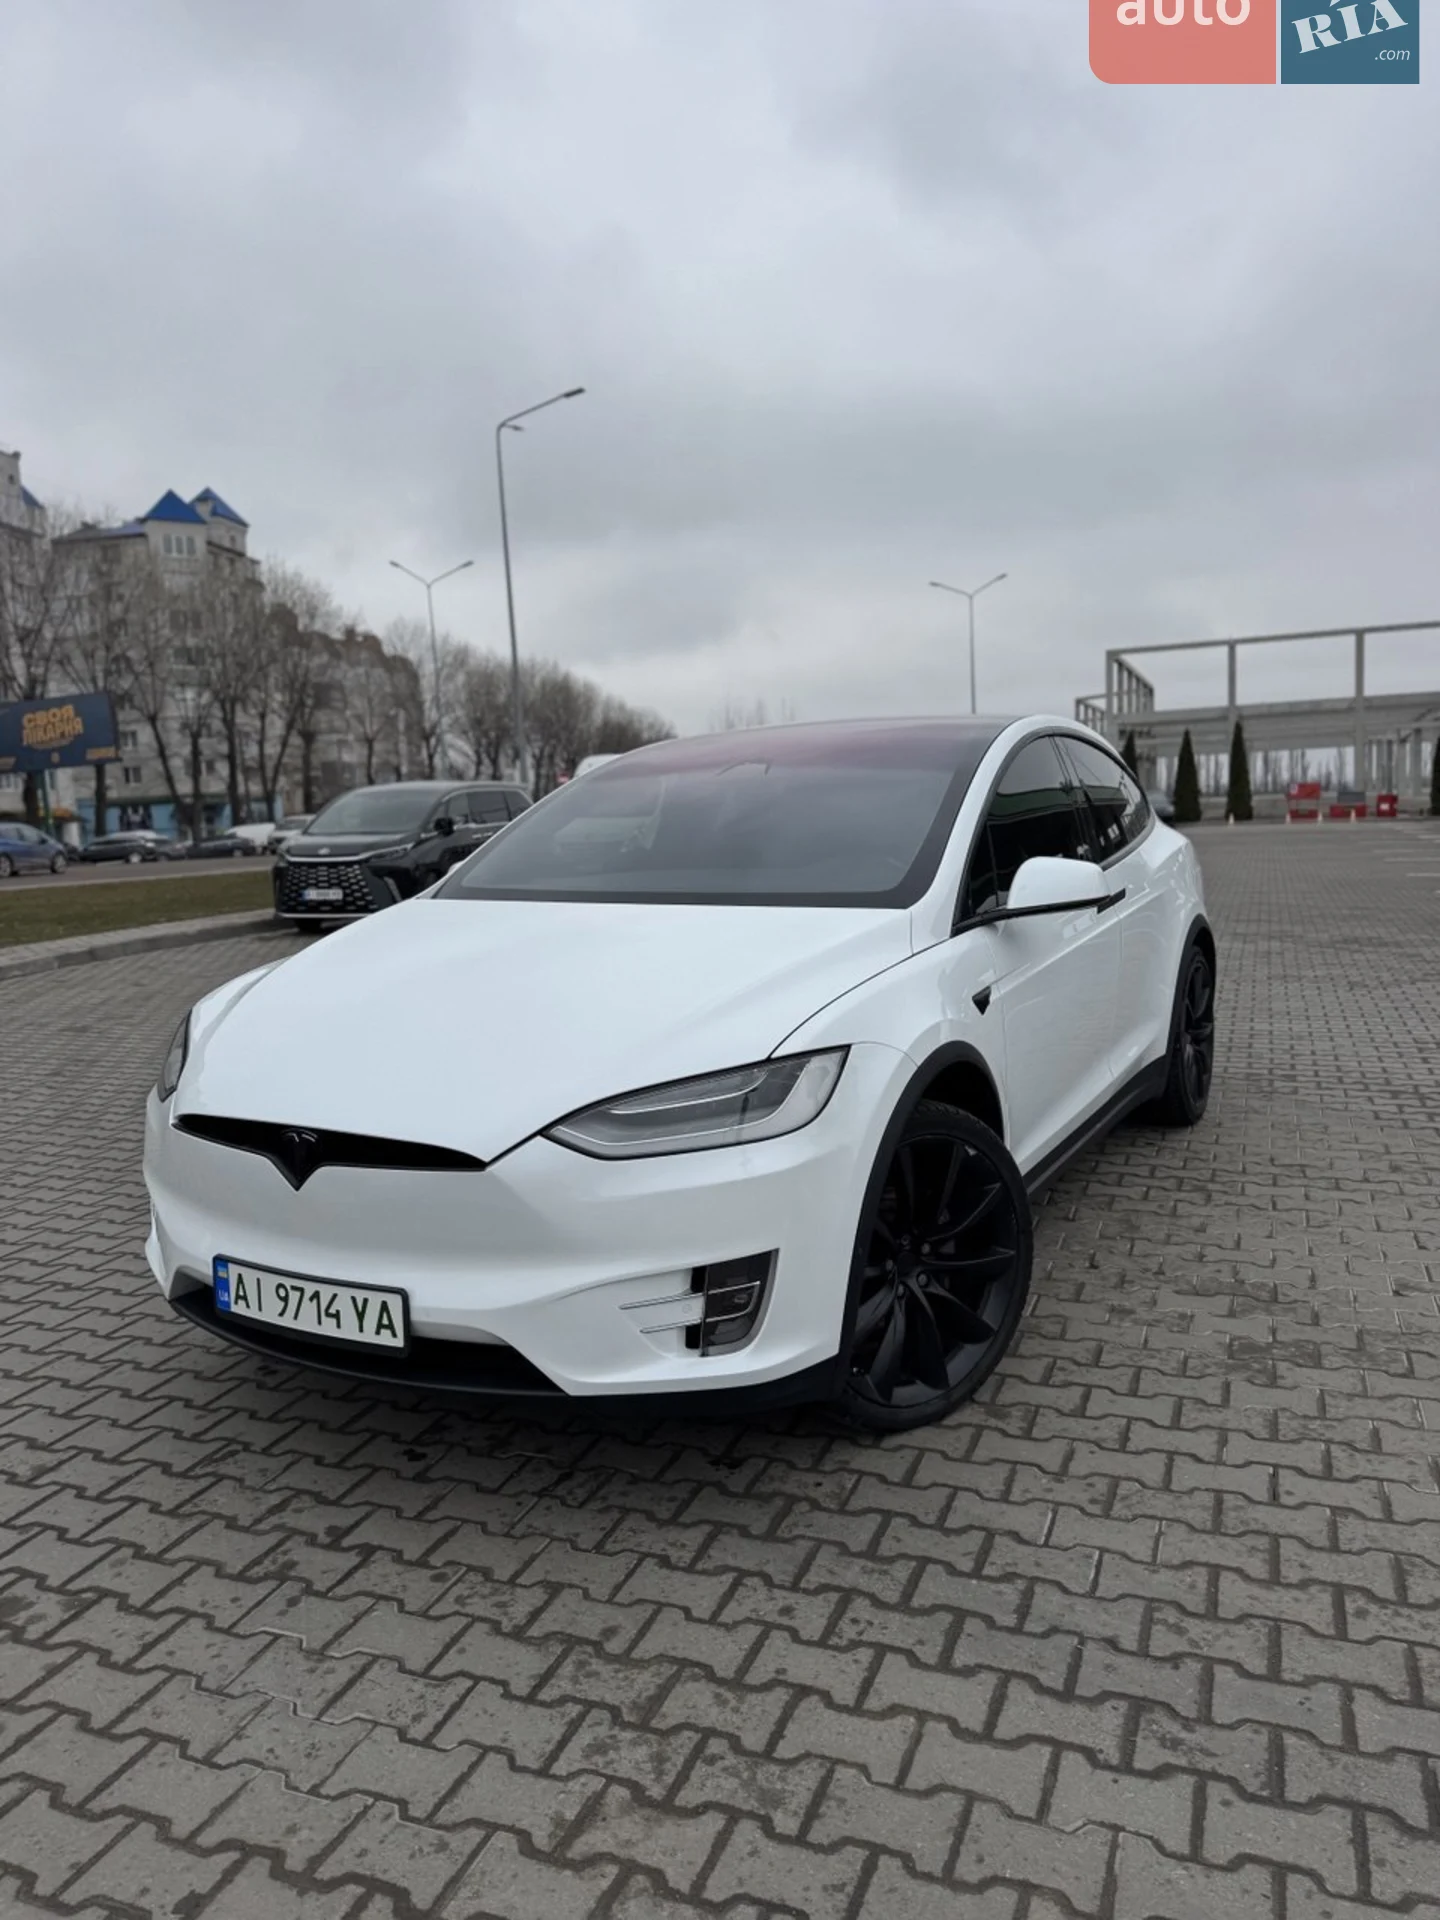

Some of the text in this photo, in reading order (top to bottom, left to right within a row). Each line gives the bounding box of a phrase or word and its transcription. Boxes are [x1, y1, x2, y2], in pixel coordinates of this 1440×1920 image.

[23, 704, 75, 729] СВОЯ
[23, 716, 84, 747] ЛІКАРНЯ
[275, 1282, 342, 1330] 9714
[350, 1295, 398, 1339] YA
